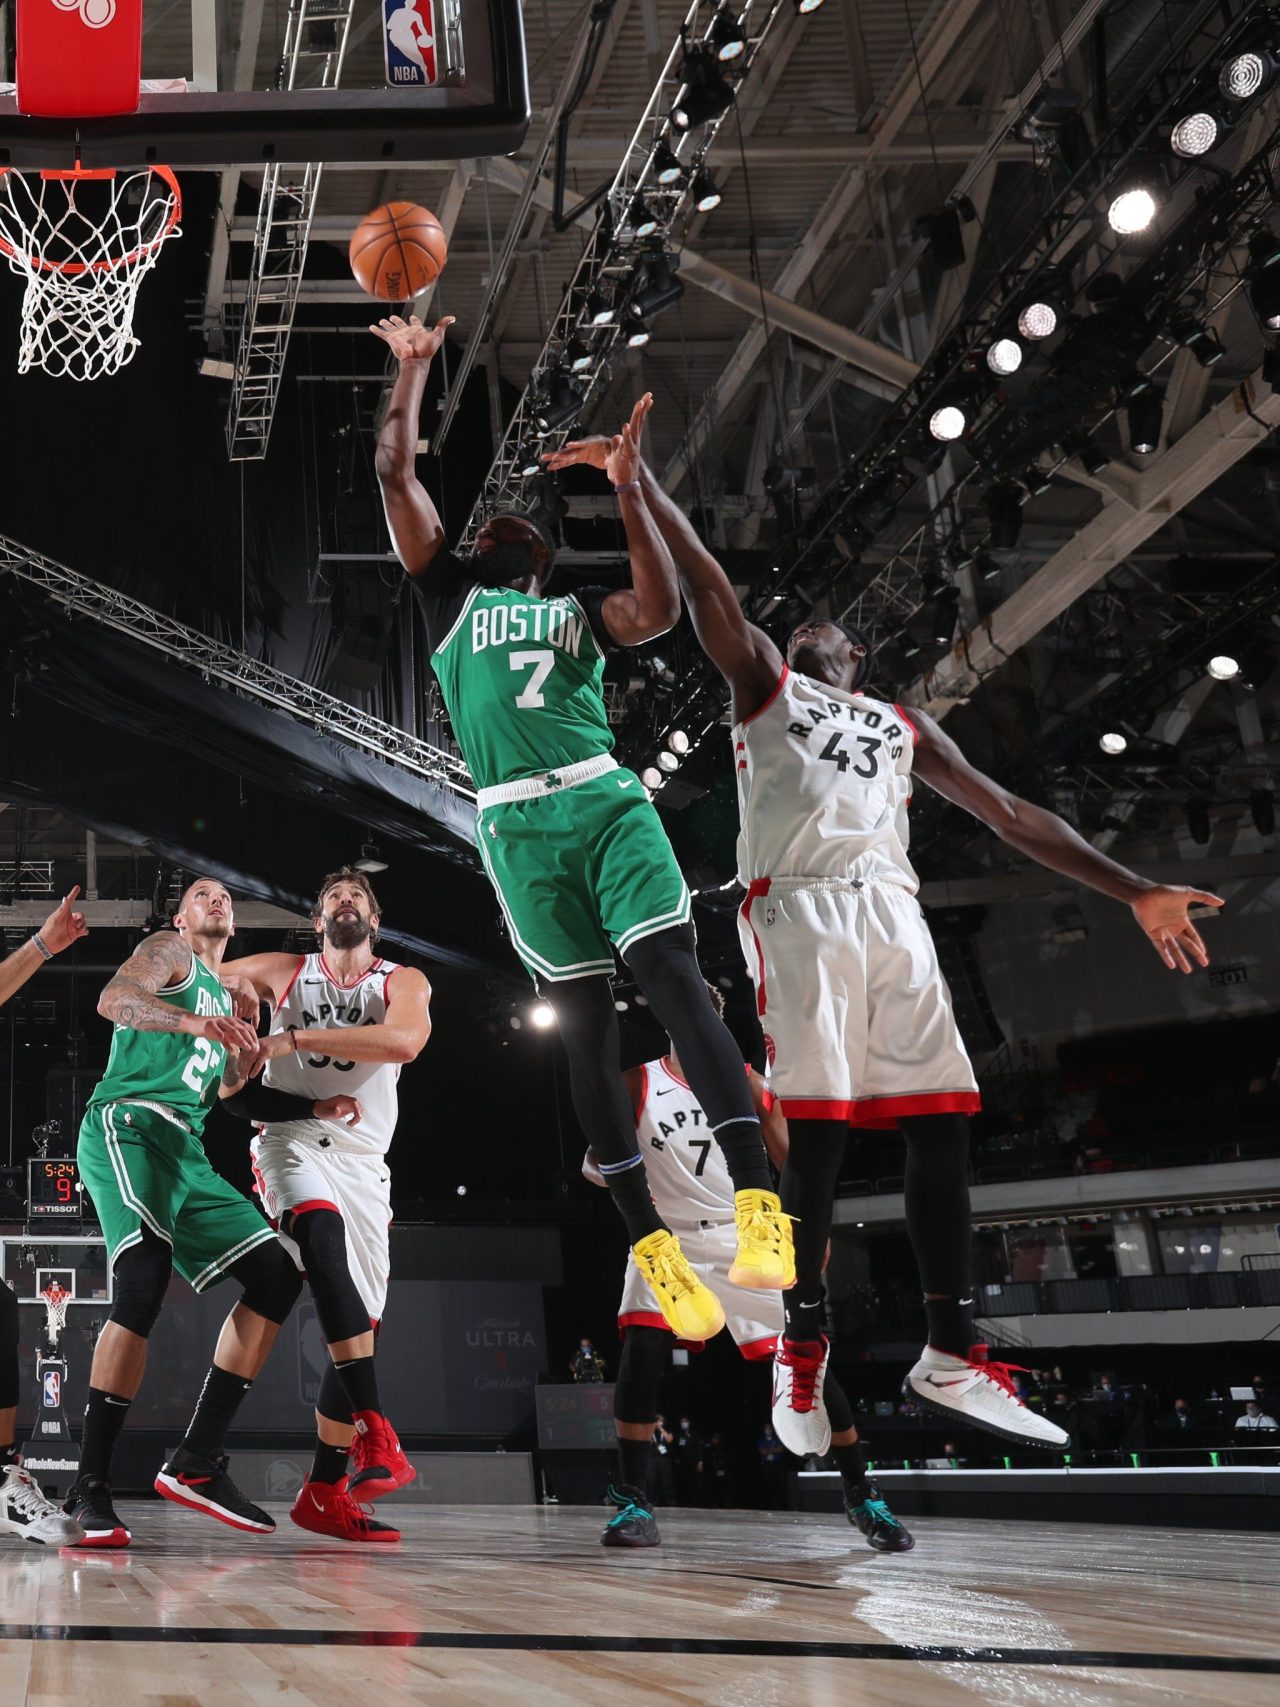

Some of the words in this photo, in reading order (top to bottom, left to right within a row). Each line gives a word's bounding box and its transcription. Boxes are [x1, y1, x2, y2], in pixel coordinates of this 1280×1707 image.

[393, 66, 418, 81] NBA
[472, 604, 584, 659] BOSTON
[509, 650, 555, 709] 7
[788, 702, 903, 760] RAPTORS
[818, 732, 882, 779] 43
[650, 1109, 702, 1152] RAPT
[45, 1164, 75, 1177] 5:24
[688, 1140, 711, 1176] 7
[57, 1178, 71, 1202] 9
[46, 1205, 78, 1213] TISSOT
[465, 1330, 536, 1347] ULTRA
[41, 1421, 61, 1434] @NBA
